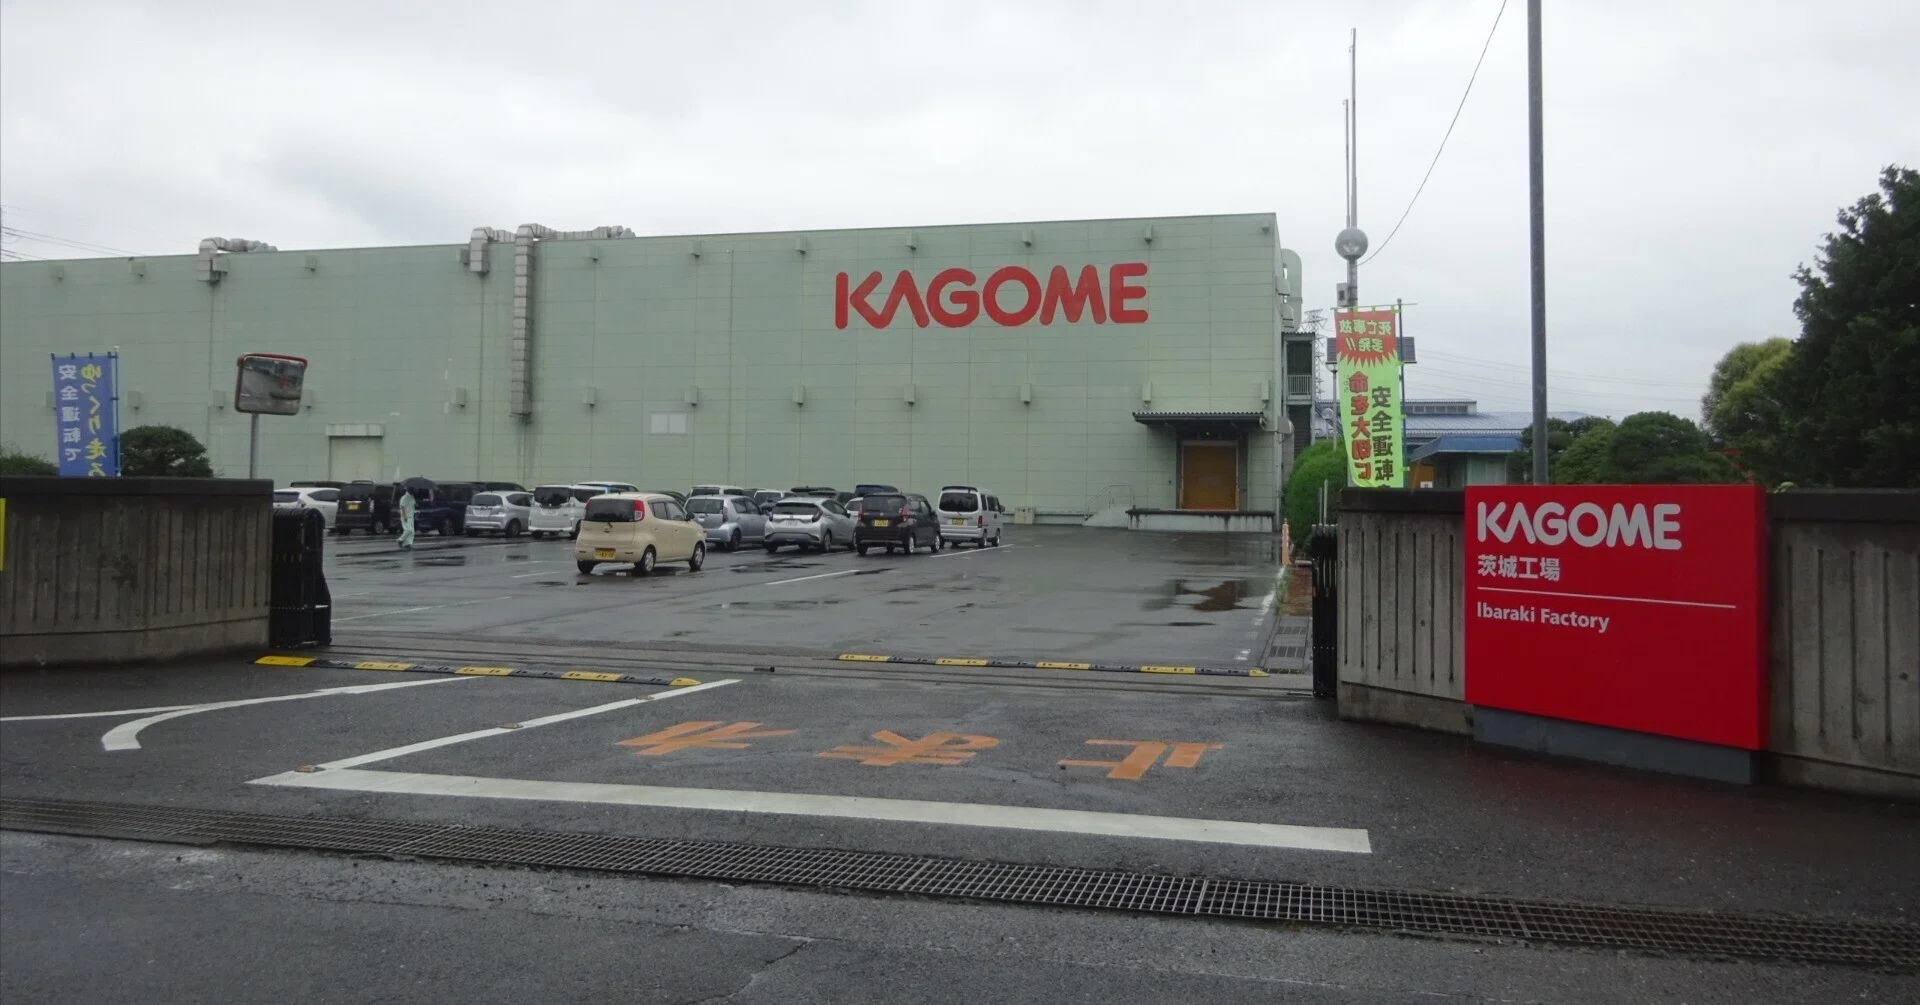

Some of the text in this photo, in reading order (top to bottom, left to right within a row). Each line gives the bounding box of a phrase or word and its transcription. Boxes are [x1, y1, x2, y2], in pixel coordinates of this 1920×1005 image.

[835, 262, 1149, 330] KAGOME
[1476, 501, 1683, 551] KAGOME
[1477, 554, 1561, 582] 茨城工場
[1476, 601, 1610, 634] Ibaraki Factory
[614, 720, 1225, 780] 止まれ
